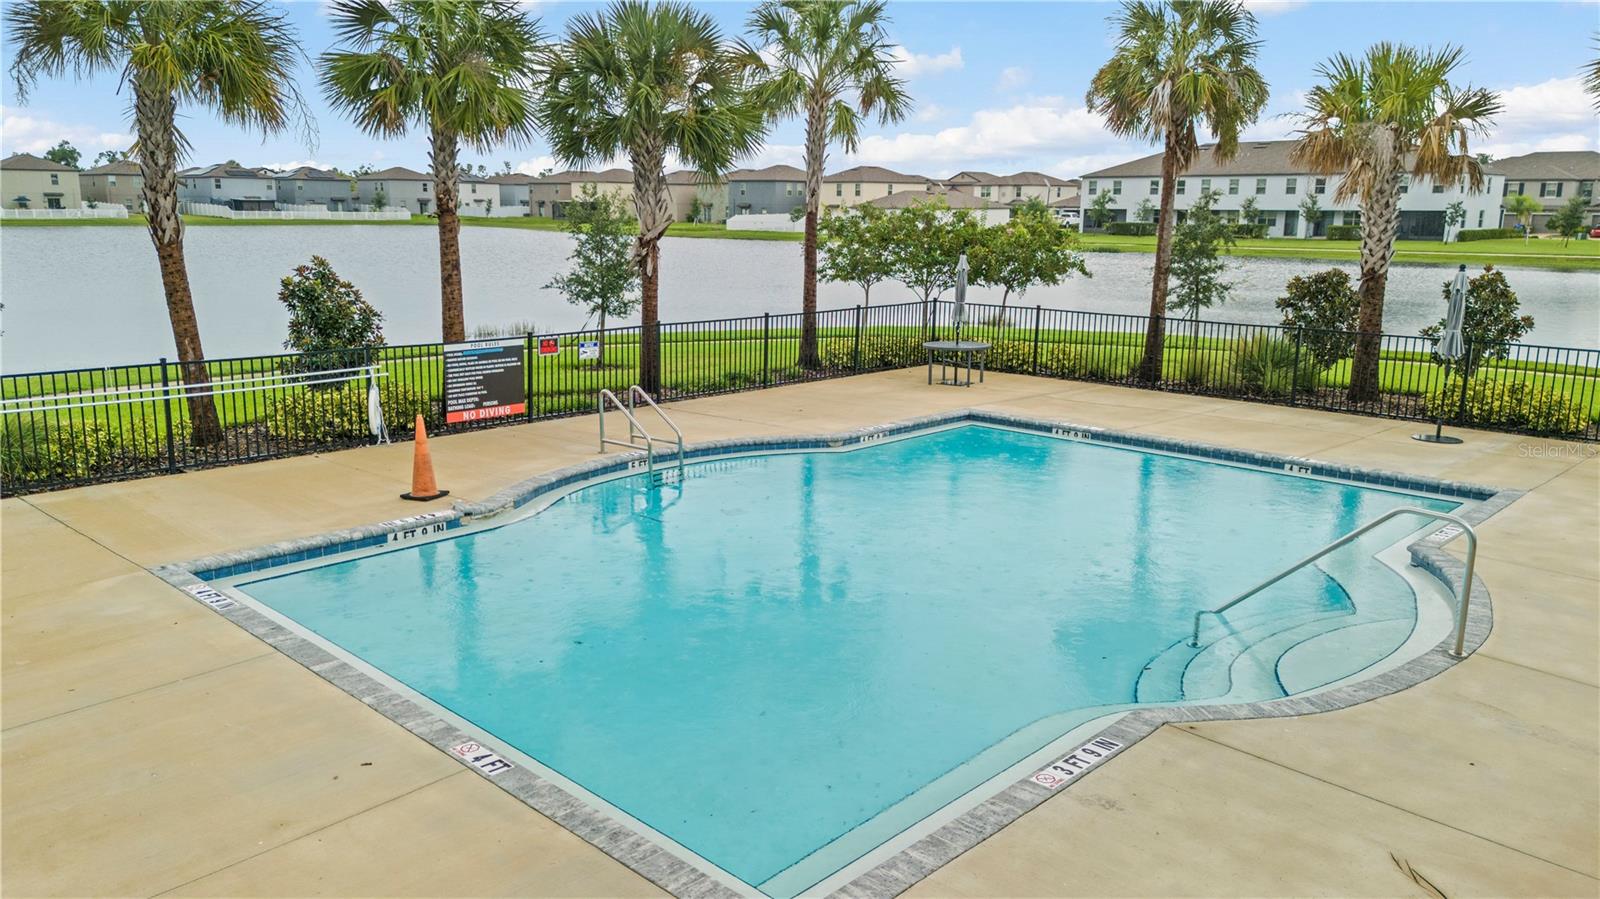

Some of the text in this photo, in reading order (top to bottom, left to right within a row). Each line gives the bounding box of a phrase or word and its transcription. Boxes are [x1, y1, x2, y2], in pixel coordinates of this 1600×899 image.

[463, 406, 511, 420] NO DIVING
[403, 529, 417, 539] FT
[433, 523, 445, 533] IN
[471, 753, 513, 773] 4 FT
[1052, 738, 1120, 776] 3 FT 9 IN
